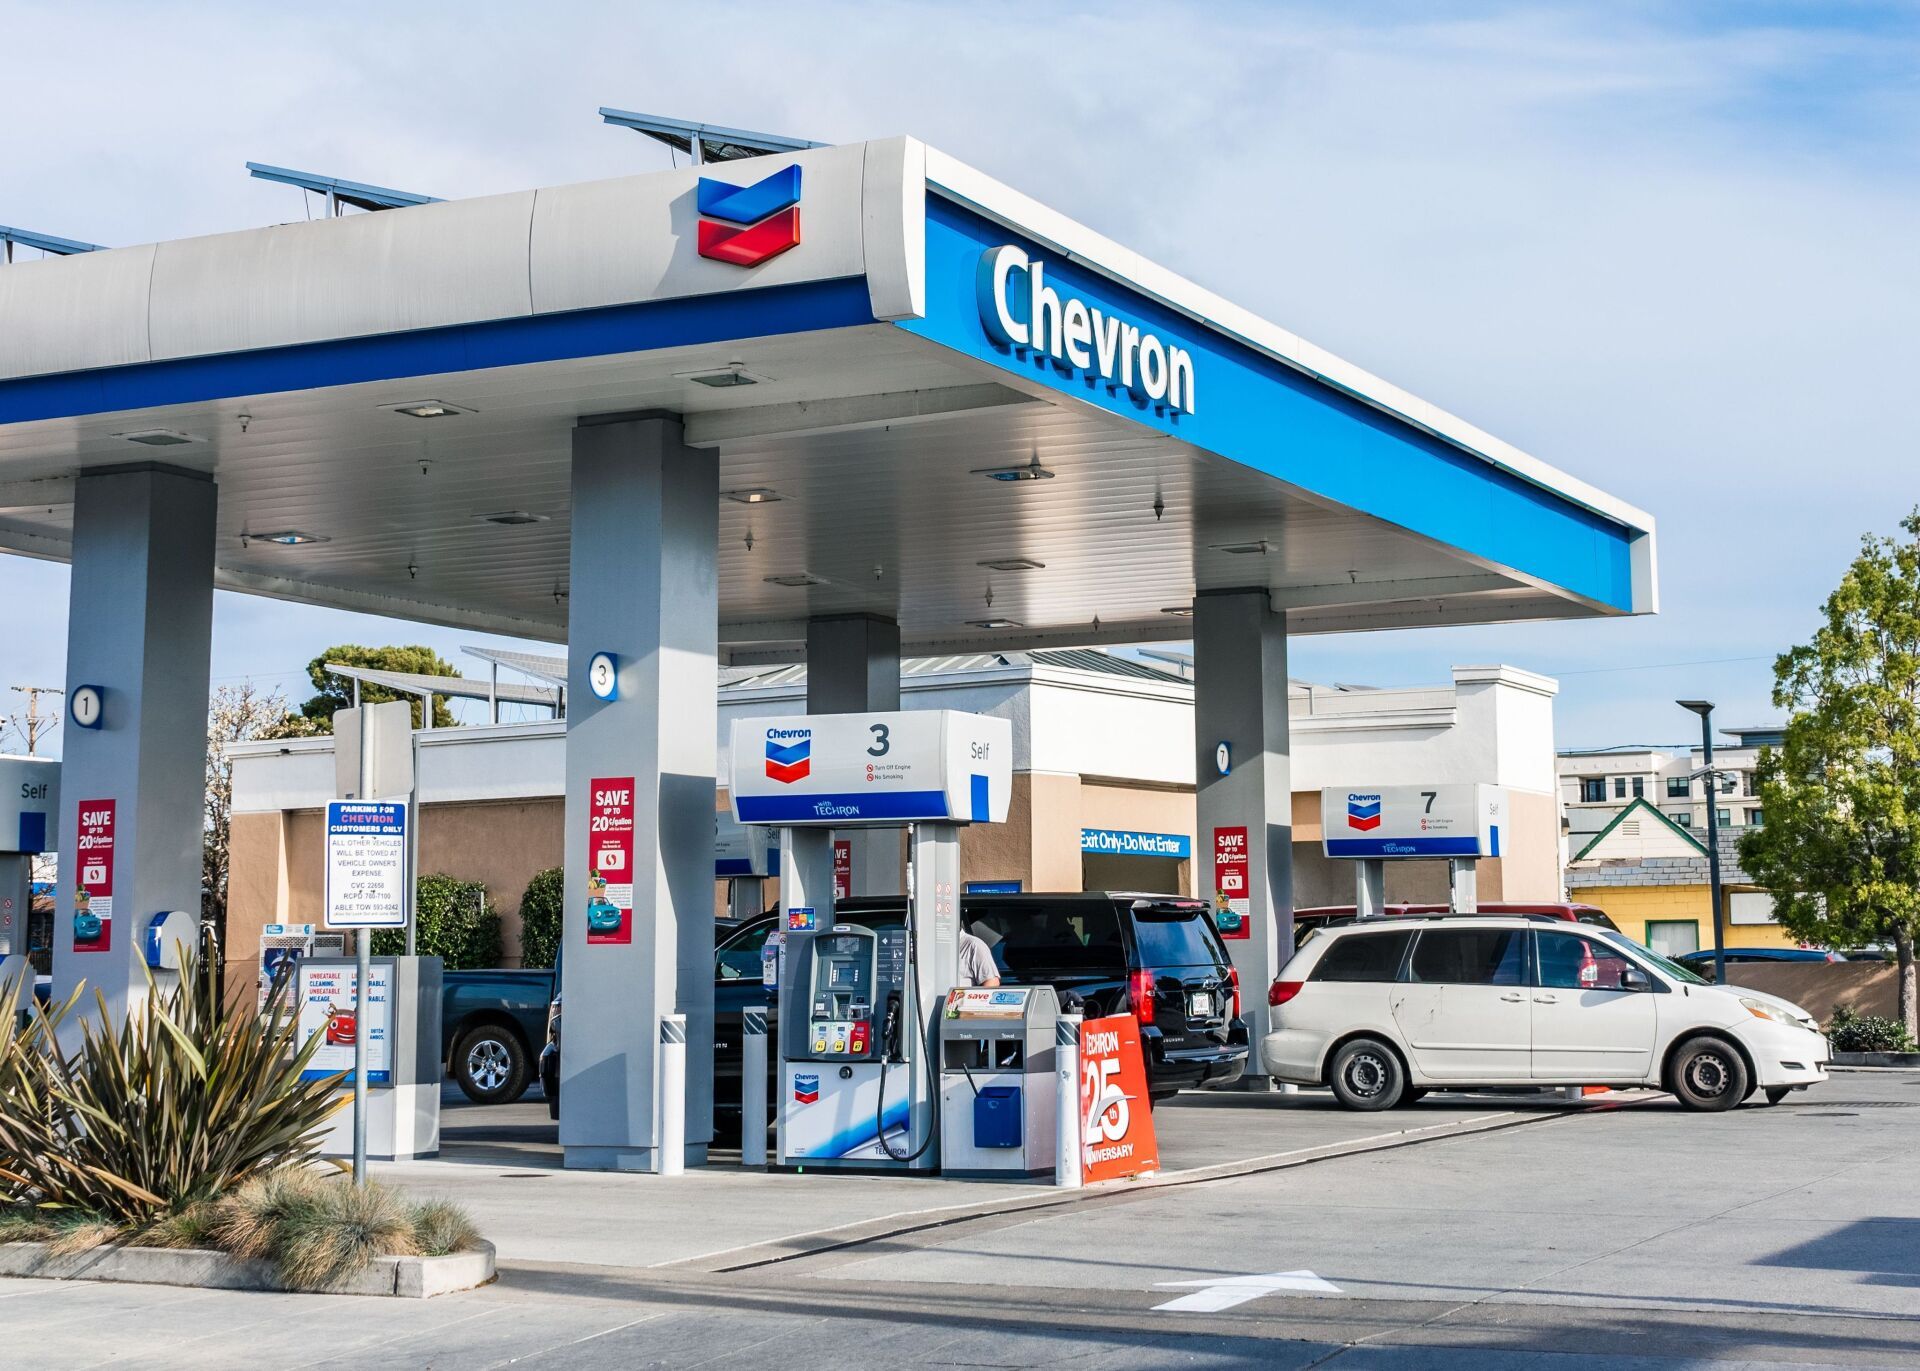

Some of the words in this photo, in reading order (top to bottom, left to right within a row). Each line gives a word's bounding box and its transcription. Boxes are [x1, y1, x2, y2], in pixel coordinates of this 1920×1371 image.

[991, 244, 1195, 416] Chevron
[598, 664, 607, 686] 3
[83, 696, 89, 716] 1
[766, 728, 812, 739] Chevron
[866, 723, 890, 757] 3
[971, 741, 990, 761] Self
[1220, 750, 1225, 765] 7
[21, 783, 48, 799] Self
[596, 790, 630, 806] SAVE
[1348, 793, 1381, 801] Chevron
[380, 806, 395, 814] FOR
[1420, 792, 1437, 813] 7
[82, 811, 112, 826] SAVE
[341, 814, 394, 823] CHEVRON
[813, 805, 860, 817] TECHRON
[1081, 831, 1098, 848] Exit
[1139, 835, 1156, 852] Not
[1157, 836, 1180, 854] Enter
[1218, 835, 1244, 847] SAVE
[834, 848, 848, 859] VE
[1382, 845, 1416, 854] TECHRON
[967, 992, 989, 1000] save
[1086, 1031, 1119, 1058] TECHRON
[1086, 1058, 1130, 1145] 25
[1109, 1107, 1117, 1120] th
